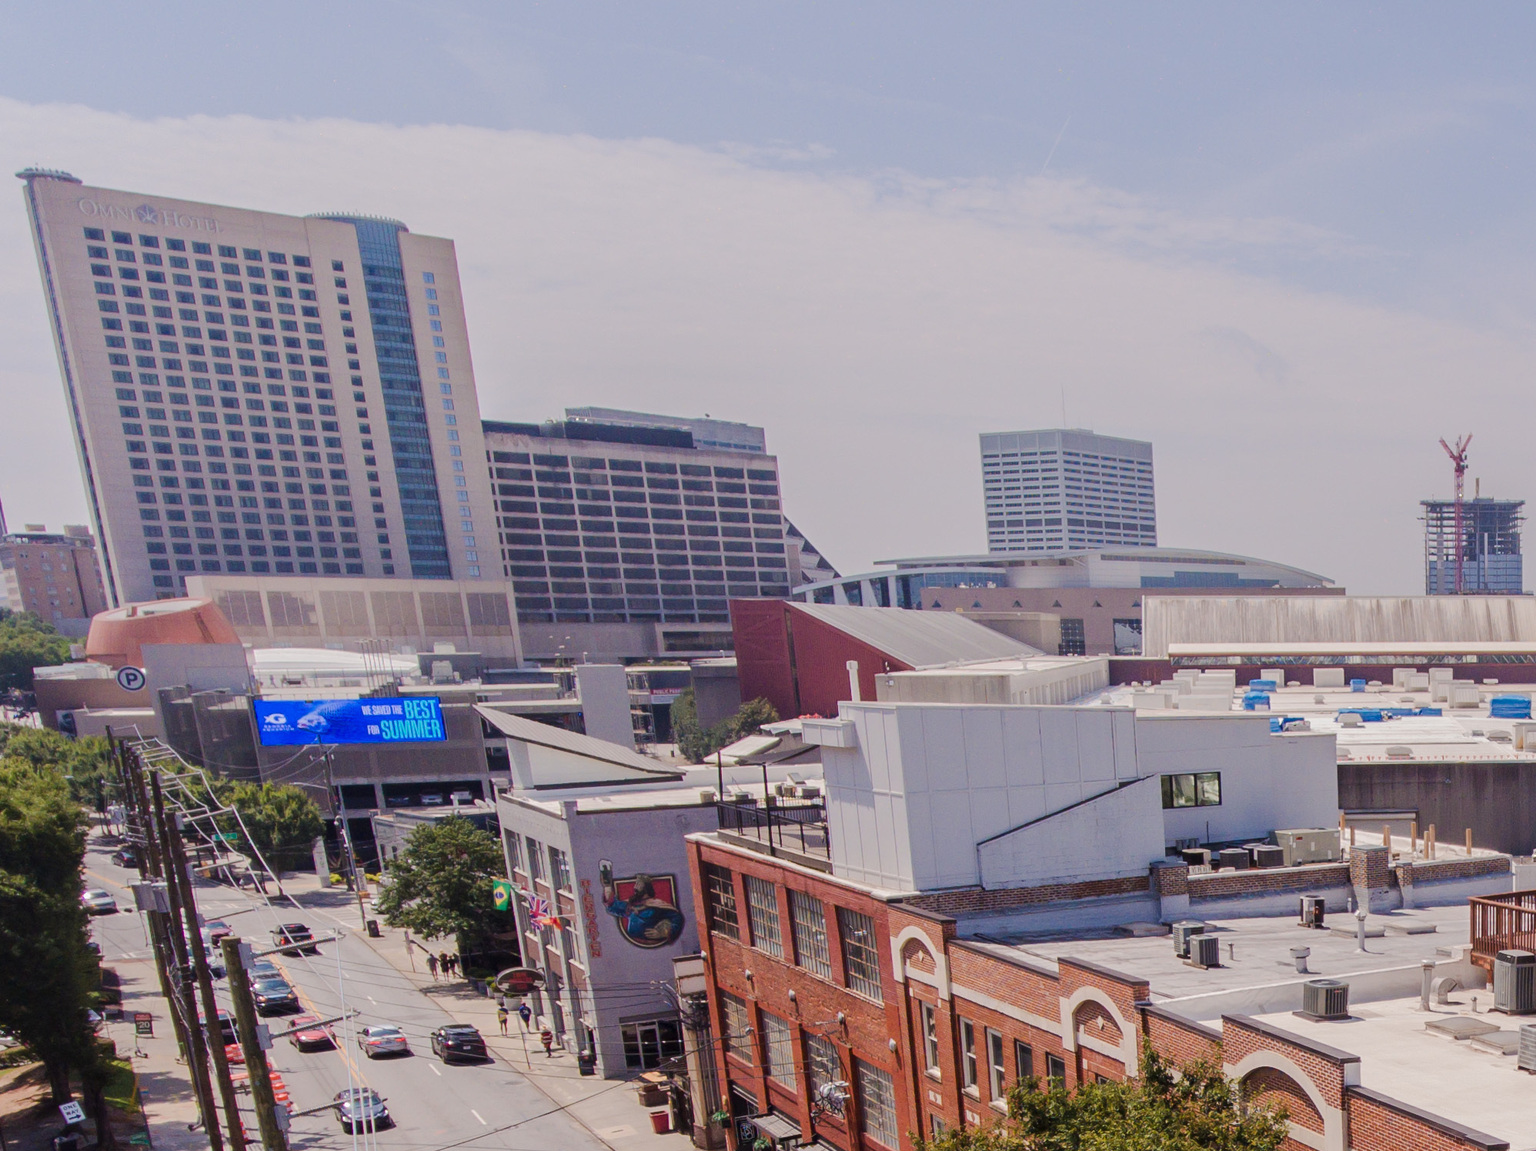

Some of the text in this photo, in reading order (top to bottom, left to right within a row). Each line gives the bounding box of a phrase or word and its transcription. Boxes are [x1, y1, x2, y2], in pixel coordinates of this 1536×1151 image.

[79, 199, 224, 233] OMNI HOTEL
[125, 673, 138, 686] P
[361, 699, 436, 719] WE SAVED THE BEST
[367, 719, 441, 739] FOR SUMMER
